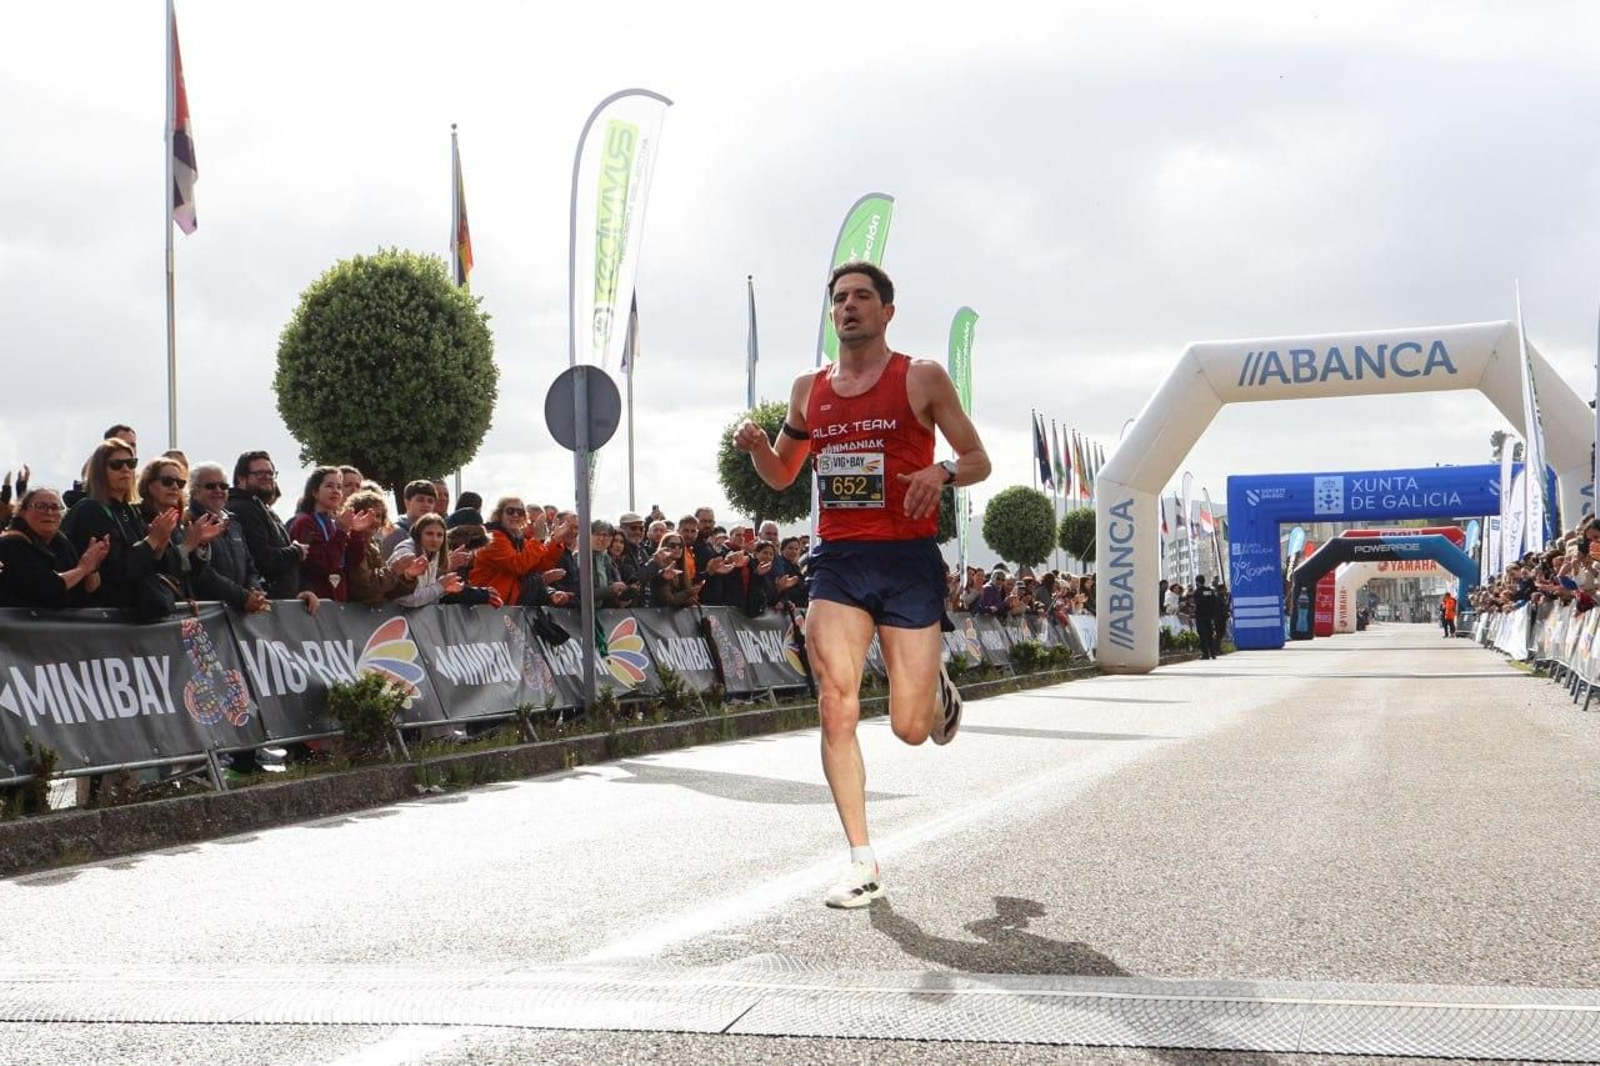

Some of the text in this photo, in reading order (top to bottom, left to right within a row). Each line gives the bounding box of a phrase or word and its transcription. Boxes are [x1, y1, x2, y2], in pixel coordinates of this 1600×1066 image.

[812, 419, 896, 439] ALEX TEAM
[832, 476, 868, 495] 652
[1351, 476, 1418, 493] XUNTA
[1351, 491, 1461, 510] DE GALICIA
[1354, 543, 1420, 553] POWERADE
[1391, 560, 1437, 571] YAMAHA
[435, 641, 521, 686] MINIBAY
[10, 655, 176, 726] MINIBAY
